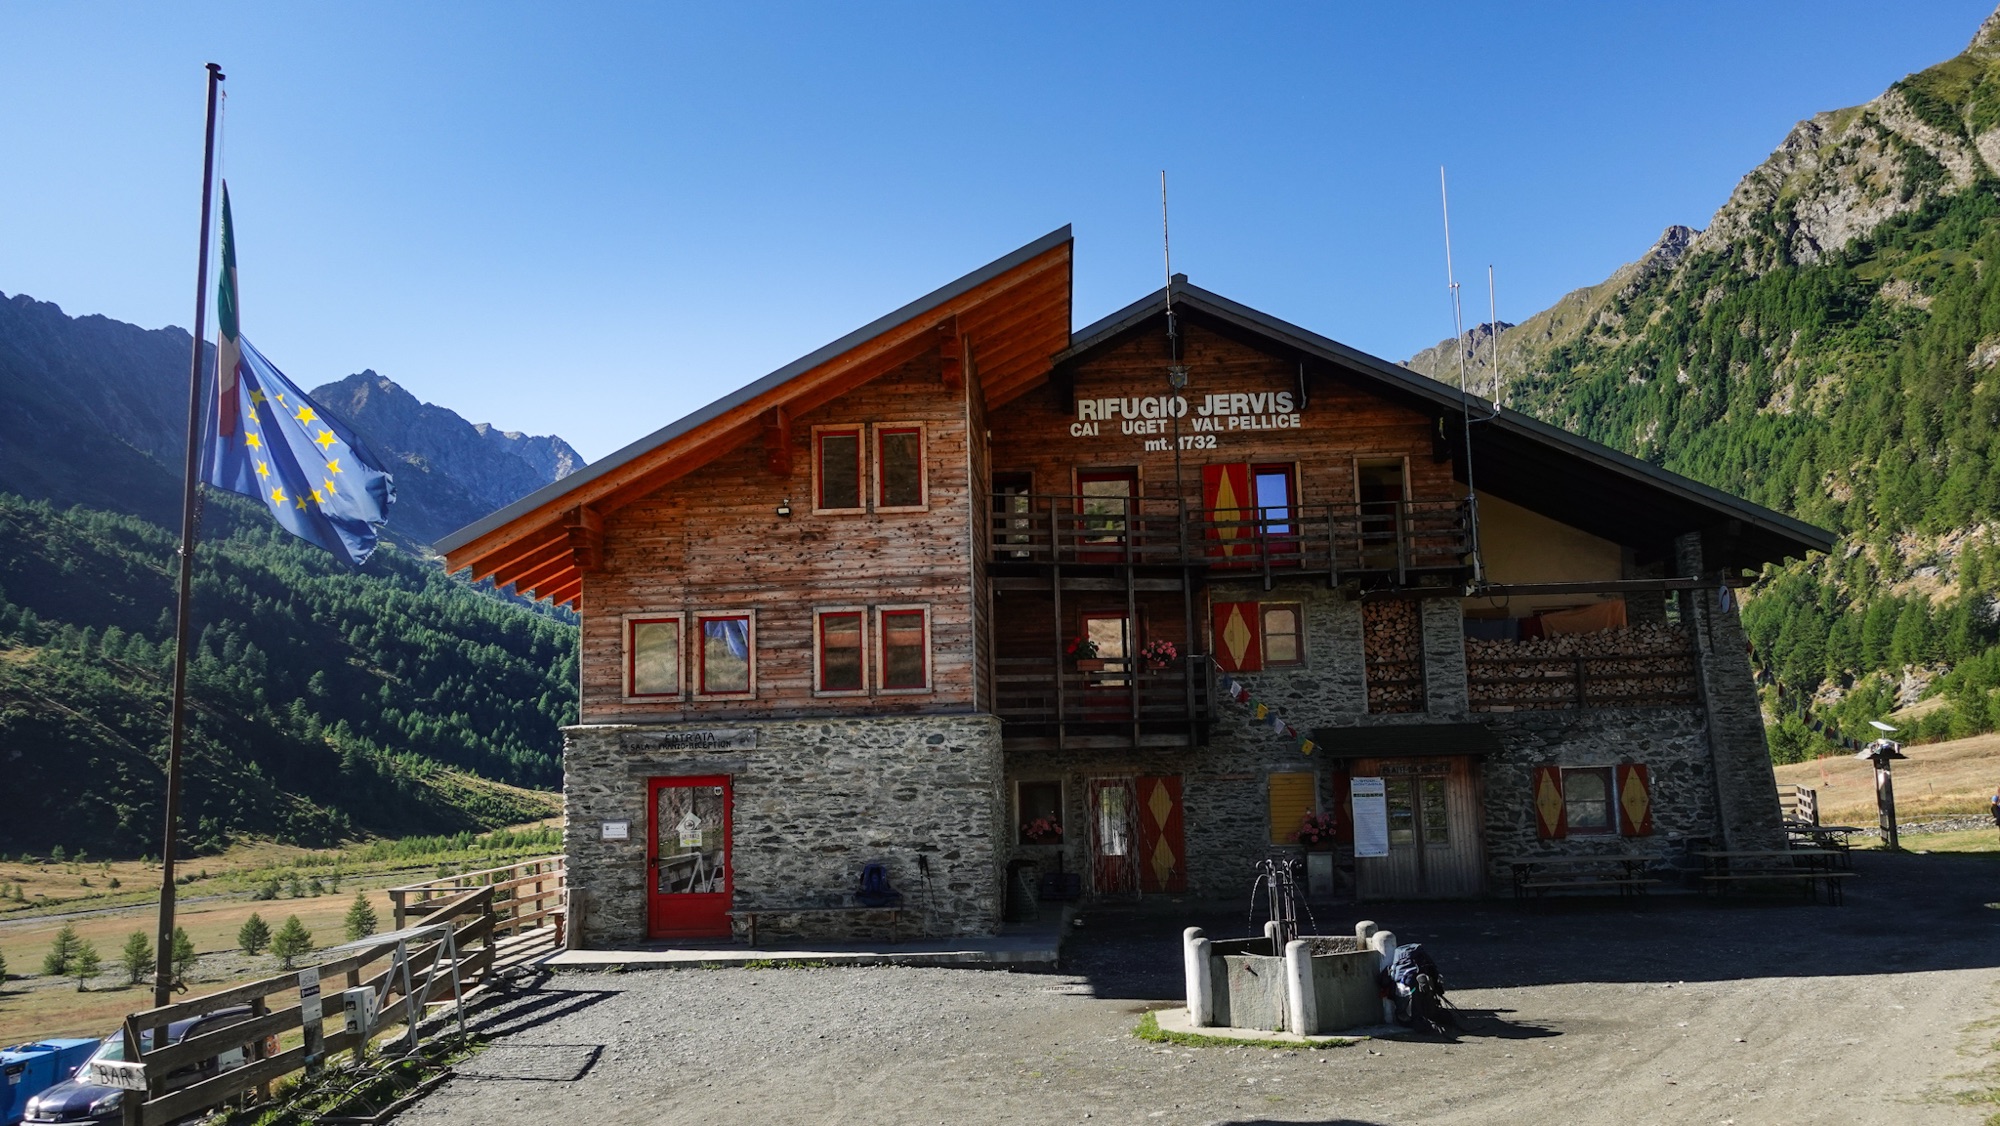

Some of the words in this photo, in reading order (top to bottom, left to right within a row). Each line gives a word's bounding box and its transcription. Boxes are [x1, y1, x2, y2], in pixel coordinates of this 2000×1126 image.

[1078, 396, 1188, 420] RIFUGIO
[1198, 392, 1294, 416] JERVIS
[1069, 422, 1099, 437] CAI
[1121, 419, 1168, 435] UGET
[1191, 417, 1224, 432] VAL
[1228, 413, 1301, 430] PELLICE
[1145, 437, 1173, 451] mt.
[1178, 435, 1217, 450] 1732
[664, 732, 715, 742] ENTRATA
[630, 743, 650, 751] SALA
[99, 1065, 130, 1086] BAR
